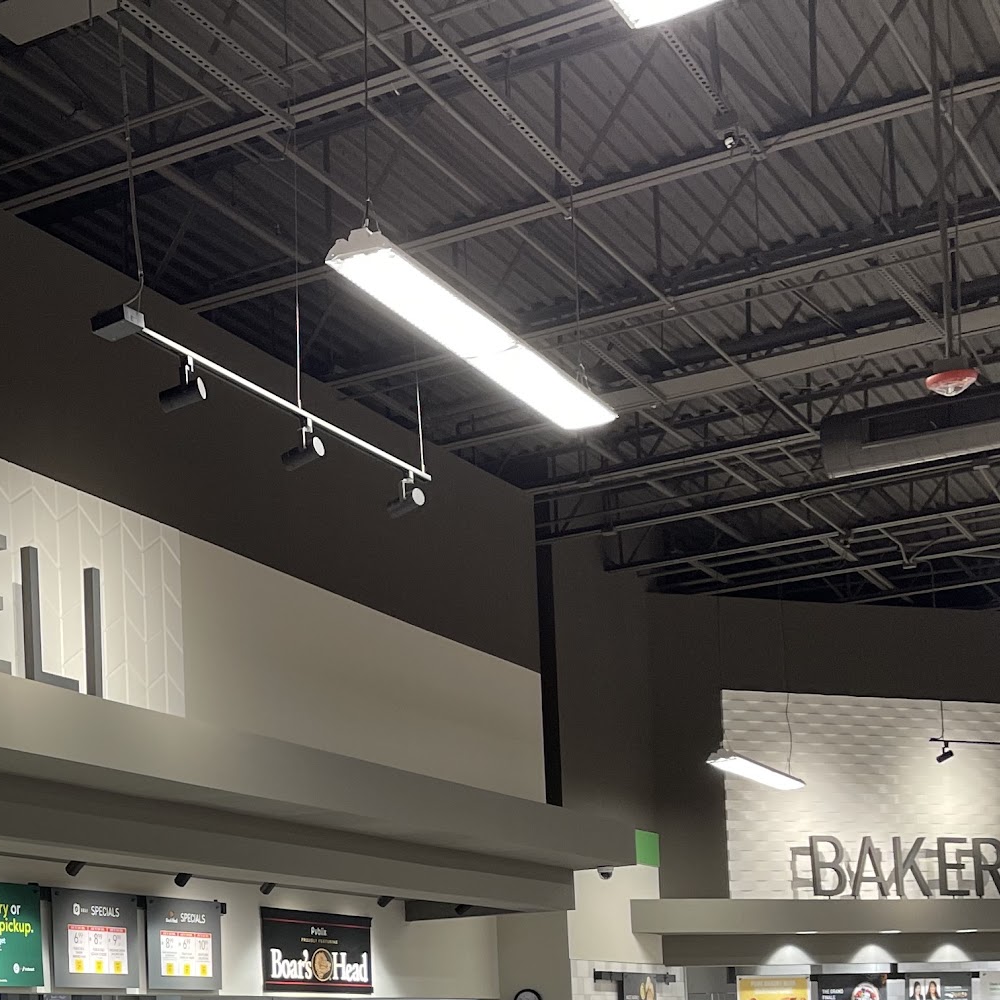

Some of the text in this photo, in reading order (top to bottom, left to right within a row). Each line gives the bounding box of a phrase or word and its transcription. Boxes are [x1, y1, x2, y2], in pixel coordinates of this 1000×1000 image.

[10, 904, 21, 915] or
[90, 906, 120, 918] SPECIALS
[180, 913, 206, 924] SPECIALS
[0, 918, 34, 937] pickup.
[311, 926, 327, 936] Publix
[270, 948, 368, 983] Boar's Head
